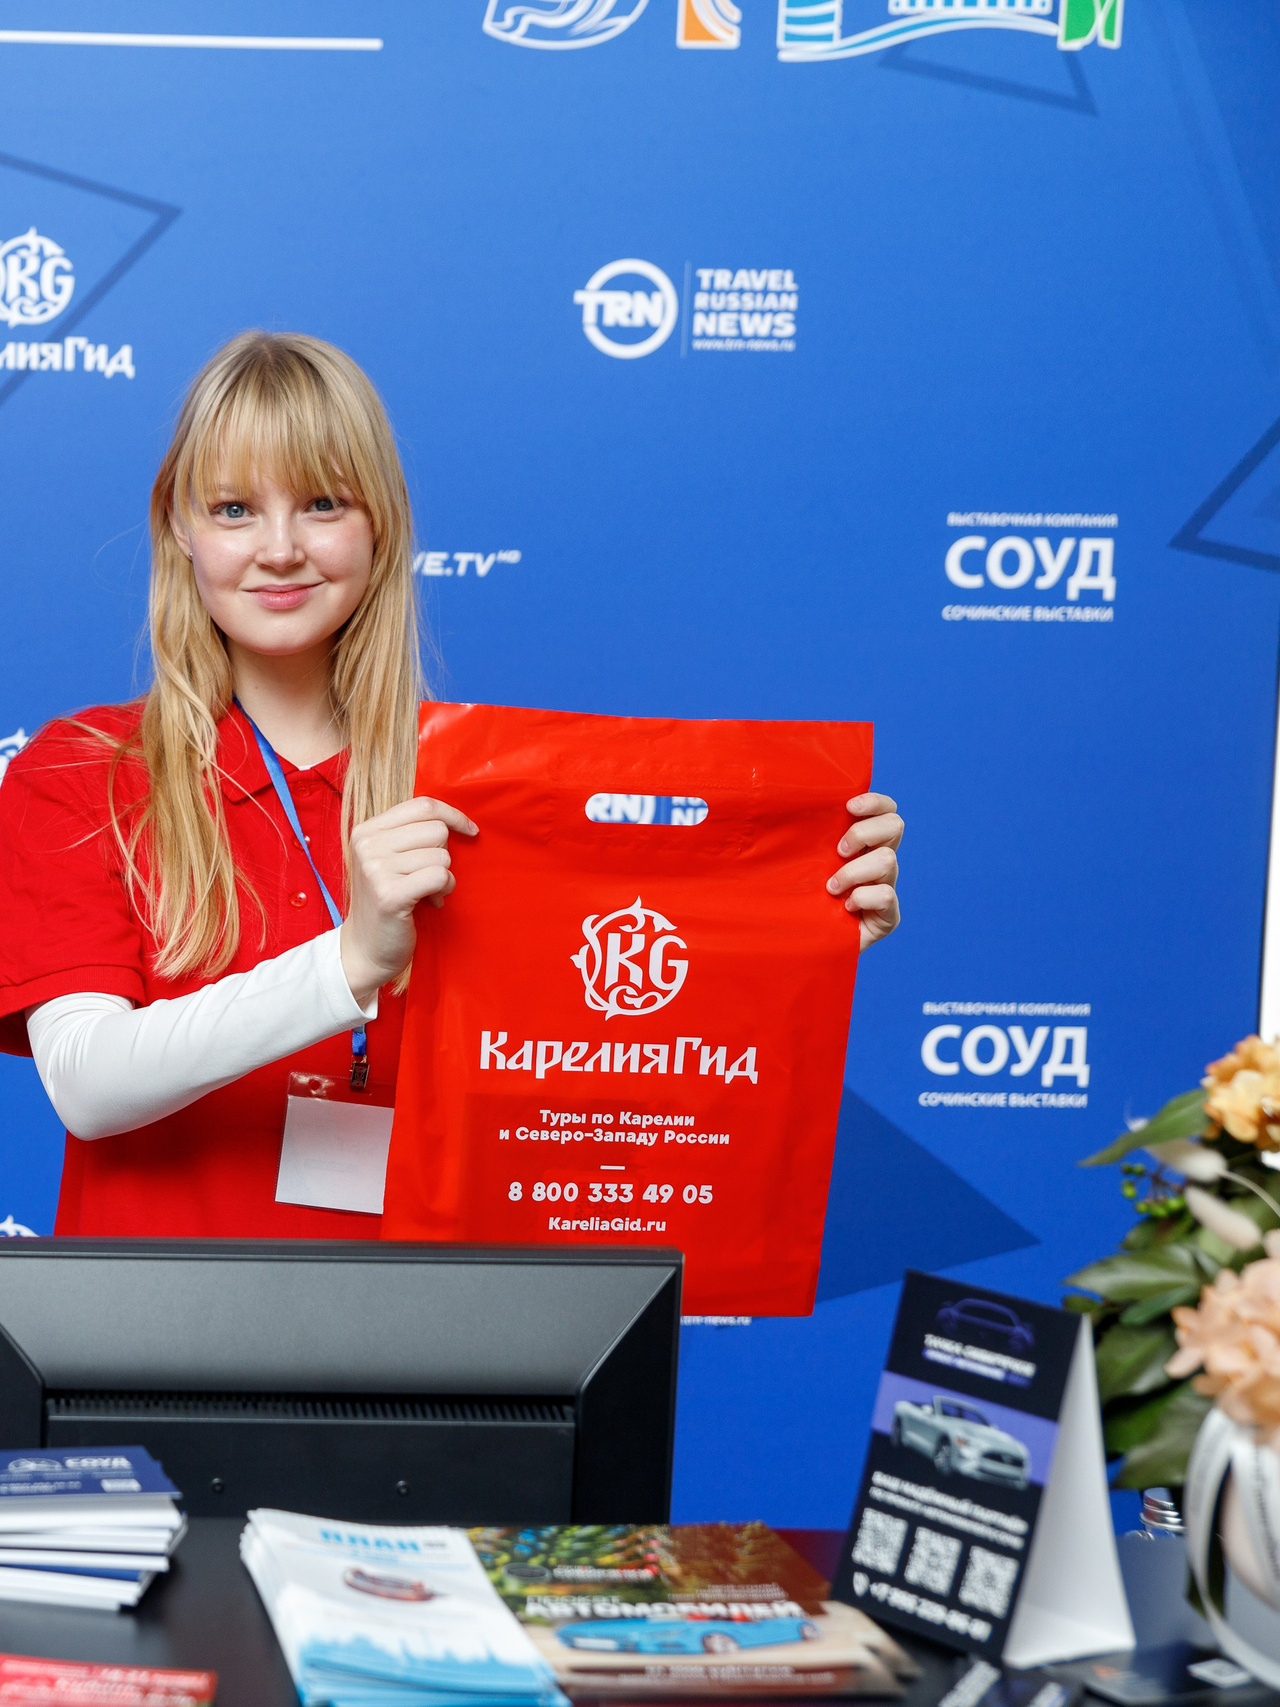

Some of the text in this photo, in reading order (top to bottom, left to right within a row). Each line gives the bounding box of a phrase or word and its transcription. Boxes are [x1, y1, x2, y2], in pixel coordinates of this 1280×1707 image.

[695, 268, 799, 292] TRAVEL
[573, 289, 664, 327] TRN
[693, 291, 799, 311] RUSSIAN
[692, 311, 797, 338] NEWS
[410, 551, 497, 578] E.TV
[944, 534, 1117, 602] СОУД
[480, 1031, 758, 1084] КарелияГид
[921, 1024, 1090, 1088] СОУД
[540, 1109, 695, 1128] Туры по Карелии
[499, 1127, 729, 1146] и Северо-Западу России
[508, 1182, 713, 1204] 8 800 333 49 05
[548, 1217, 666, 1231] KareliaGid.ru
